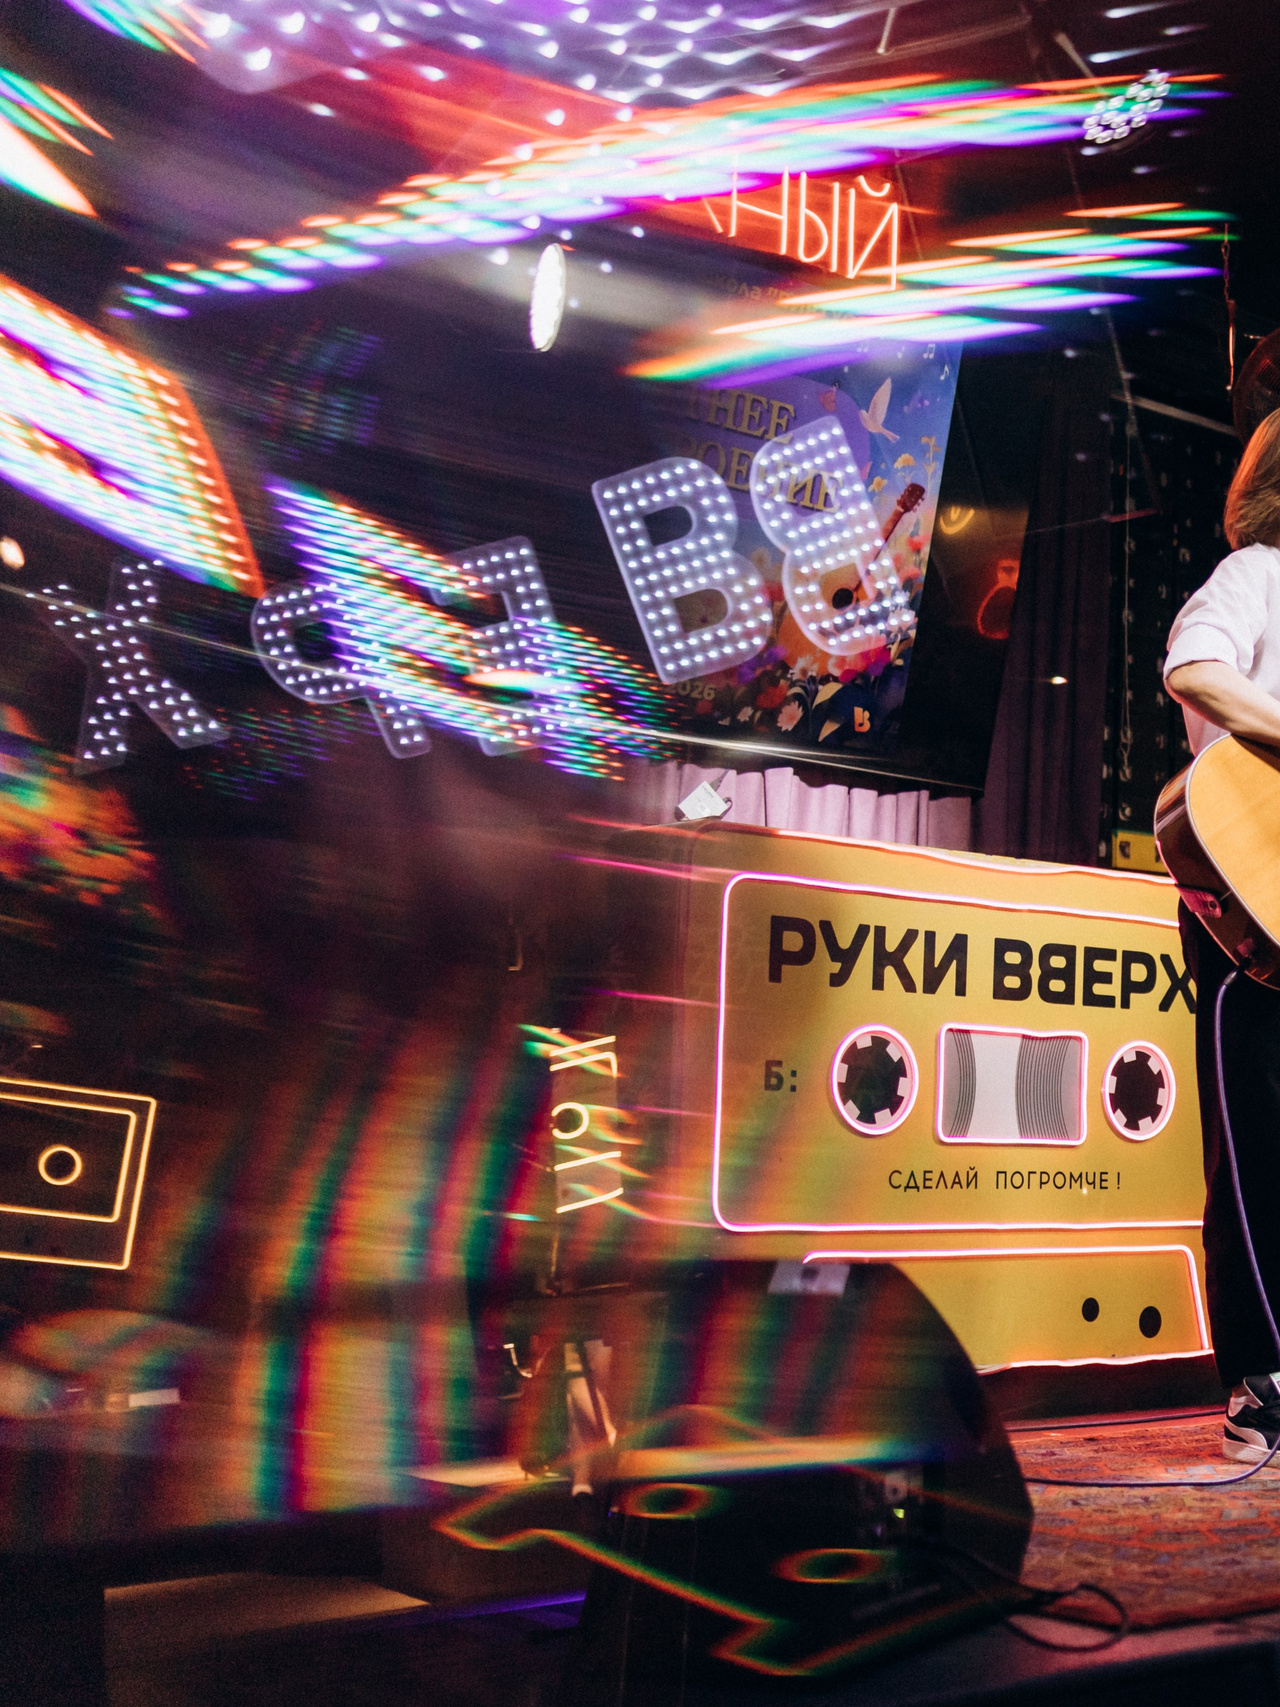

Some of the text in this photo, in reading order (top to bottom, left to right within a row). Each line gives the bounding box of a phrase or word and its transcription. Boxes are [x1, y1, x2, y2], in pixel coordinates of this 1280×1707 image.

[702, 160, 899, 291] НЫЙ
[695, 386, 796, 445] НЕЕ
[768, 915, 969, 997] РУКИ
[763, 1060, 798, 1093] Б:
[888, 1166, 979, 1193] СДЕЛАЙ
